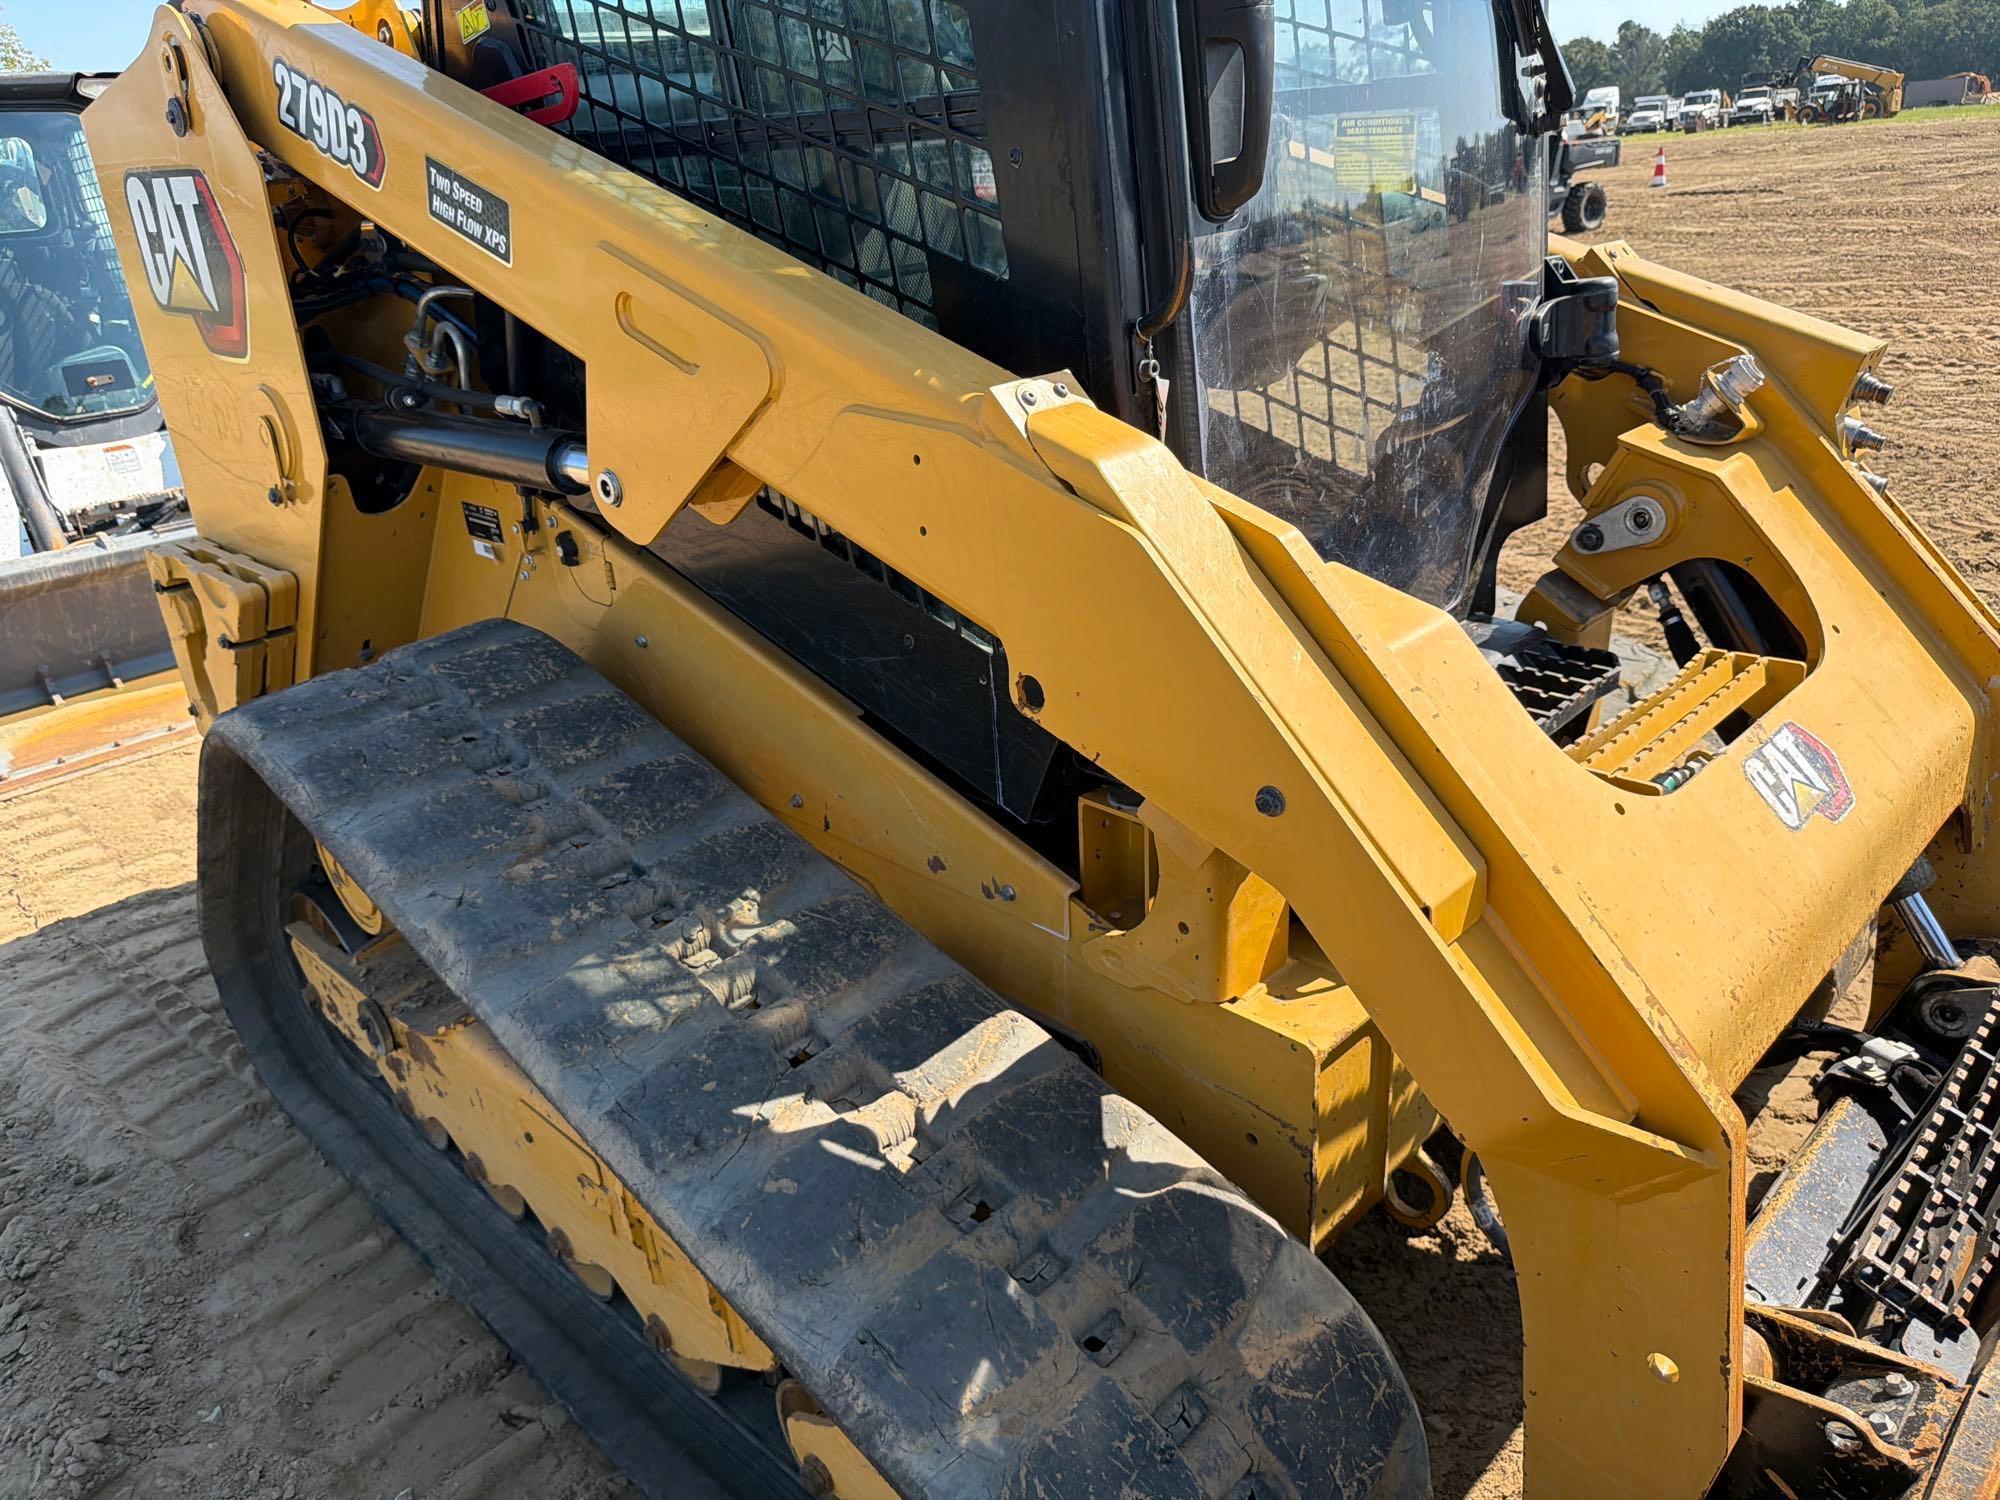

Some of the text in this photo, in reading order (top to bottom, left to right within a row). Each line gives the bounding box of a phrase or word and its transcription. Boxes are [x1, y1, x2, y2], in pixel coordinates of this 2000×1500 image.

[274, 62, 368, 175] 279D3
[1341, 119, 1356, 128] AIR
[1345, 126, 1404, 135] MAINTENANCE
[126, 176, 220, 312] CAT
[484, 224, 507, 255] XPS
[1744, 726, 1831, 828] CAT
